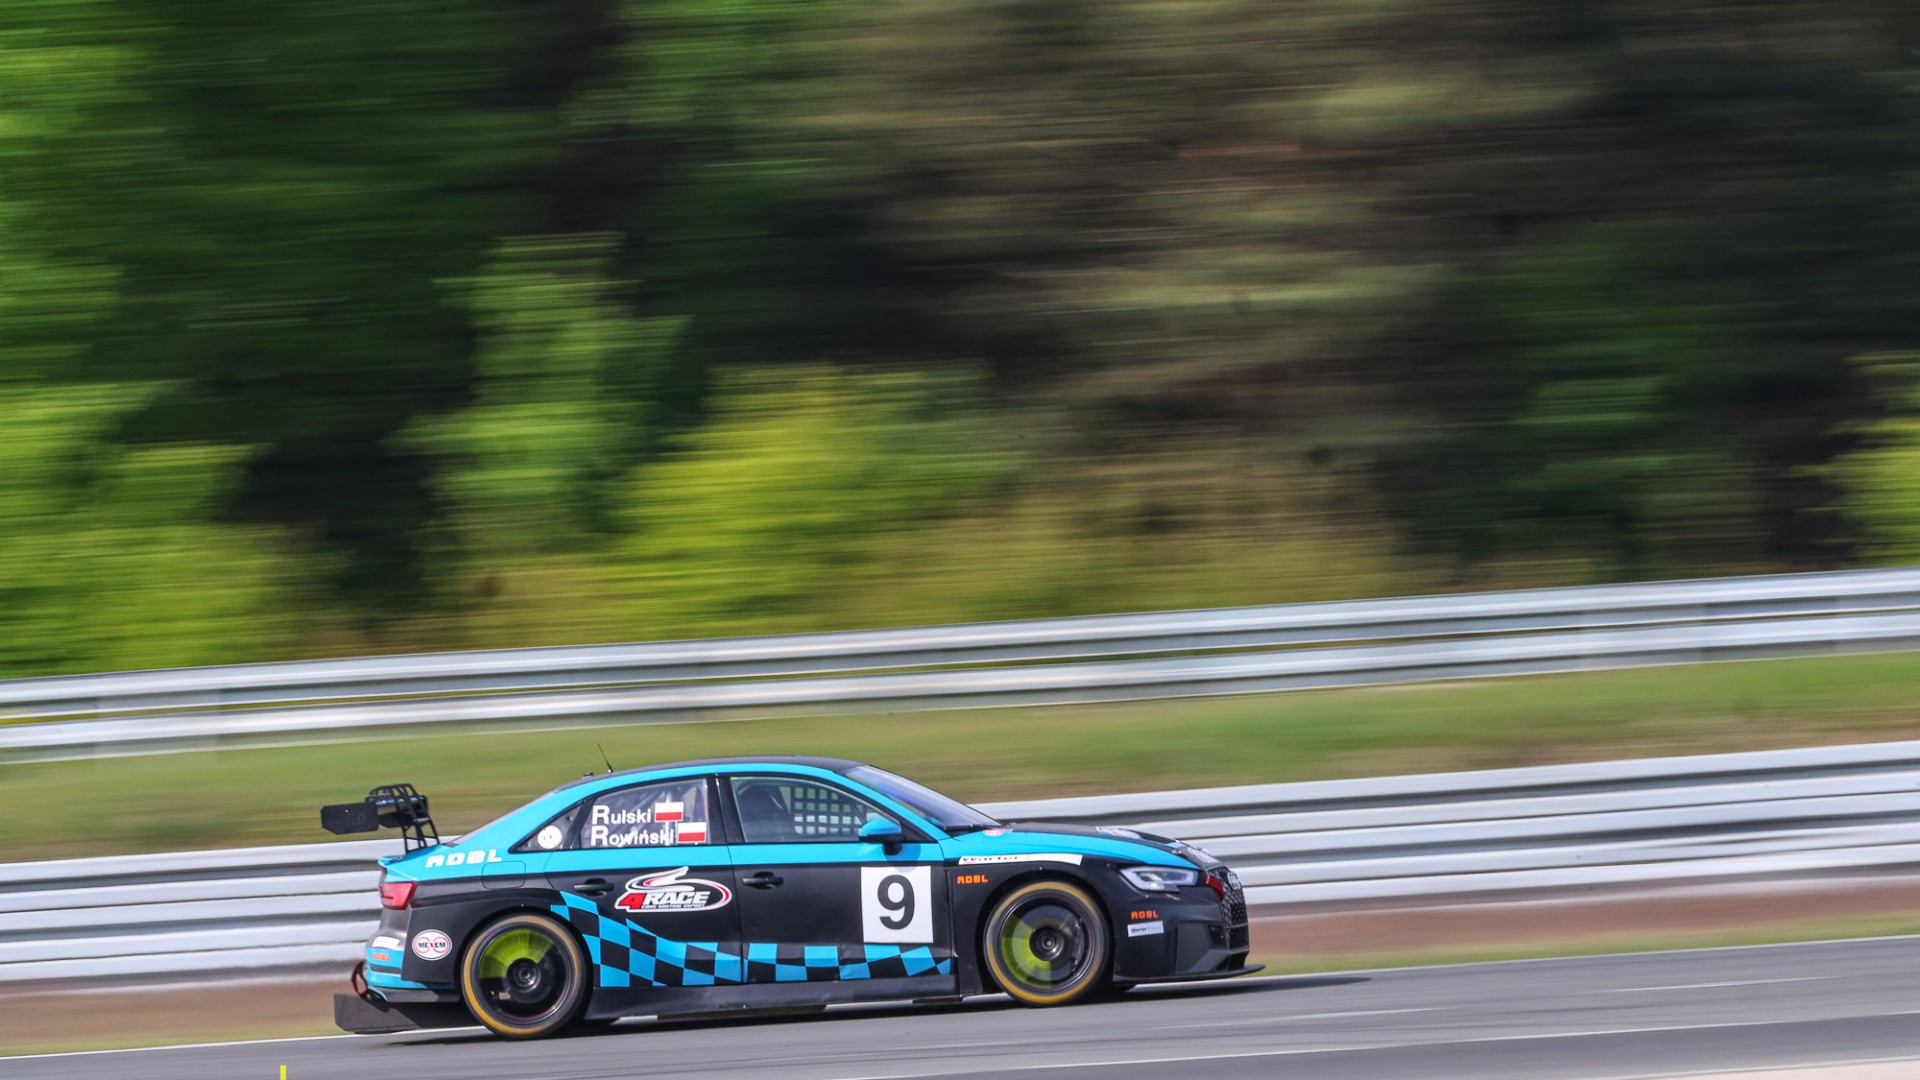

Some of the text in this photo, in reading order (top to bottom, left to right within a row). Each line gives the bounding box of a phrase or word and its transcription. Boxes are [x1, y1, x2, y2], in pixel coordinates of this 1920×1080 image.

[592, 805, 652, 824] Rulski
[590, 825, 674, 847] Rowiński
[425, 849, 502, 867] ADBL
[957, 875, 988, 884] ADBL
[619, 891, 710, 909] 4RACE
[877, 874, 915, 930] 9
[1131, 911, 1159, 919] ADBL
[418, 941, 446, 949] MEXEM
